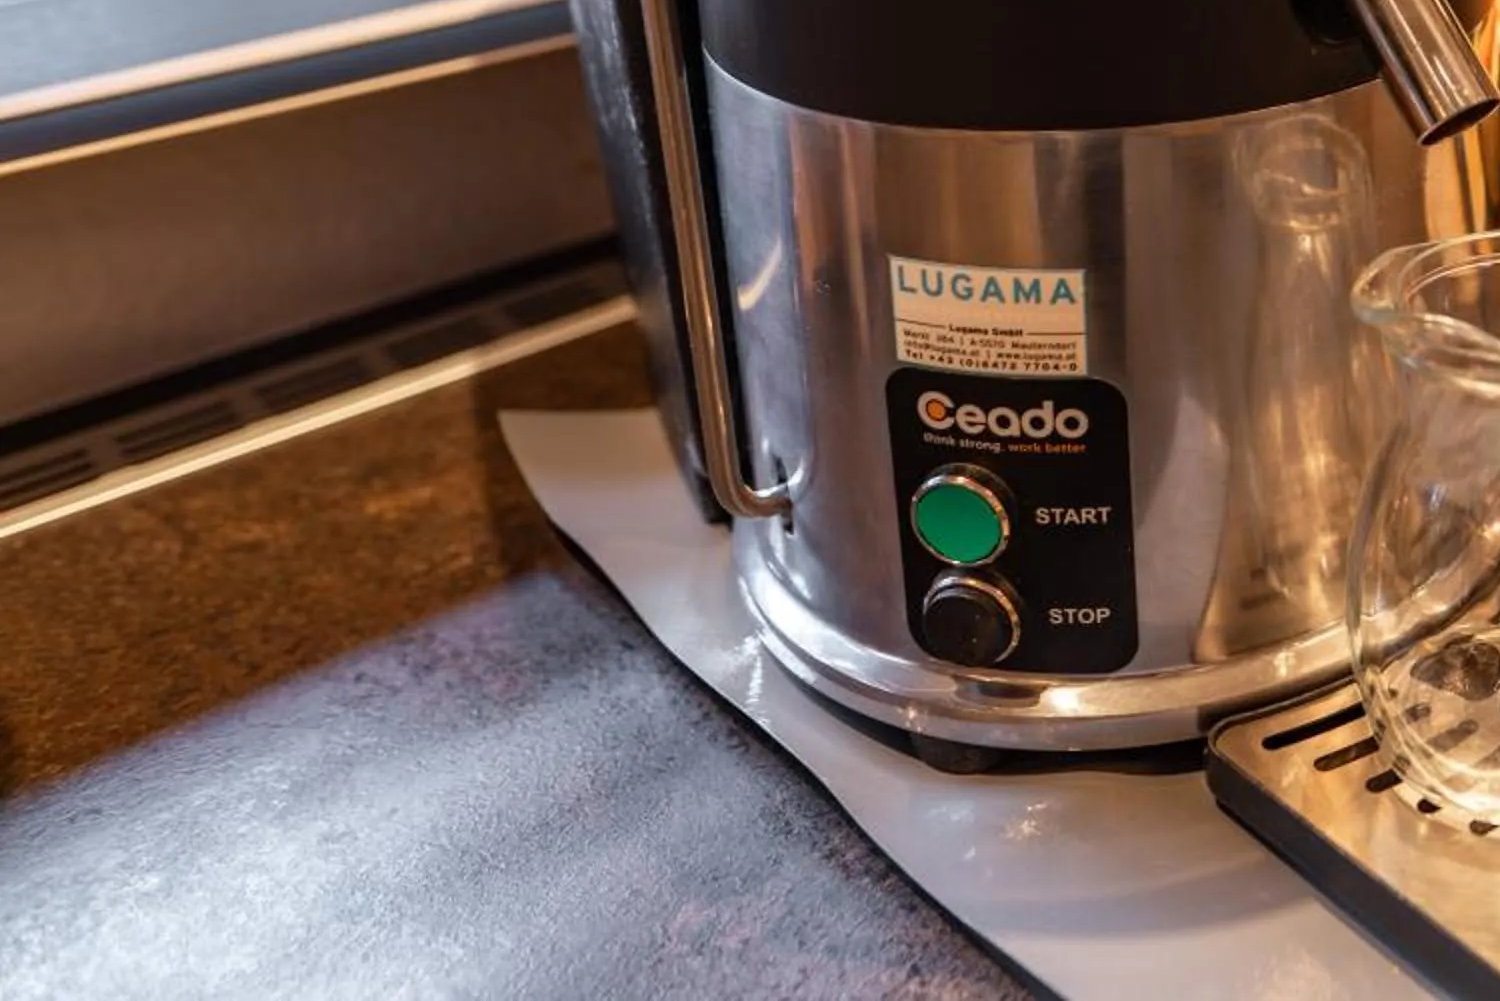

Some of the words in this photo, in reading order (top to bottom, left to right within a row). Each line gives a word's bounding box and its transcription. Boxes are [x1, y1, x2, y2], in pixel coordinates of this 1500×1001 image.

[898, 265, 1077, 305] LUGAMA
[917, 390, 1089, 439] Ceado
[1008, 443, 1041, 453] work
[1045, 442, 1087, 454] better
[1035, 506, 1112, 525] START
[1049, 607, 1112, 625] STOP
